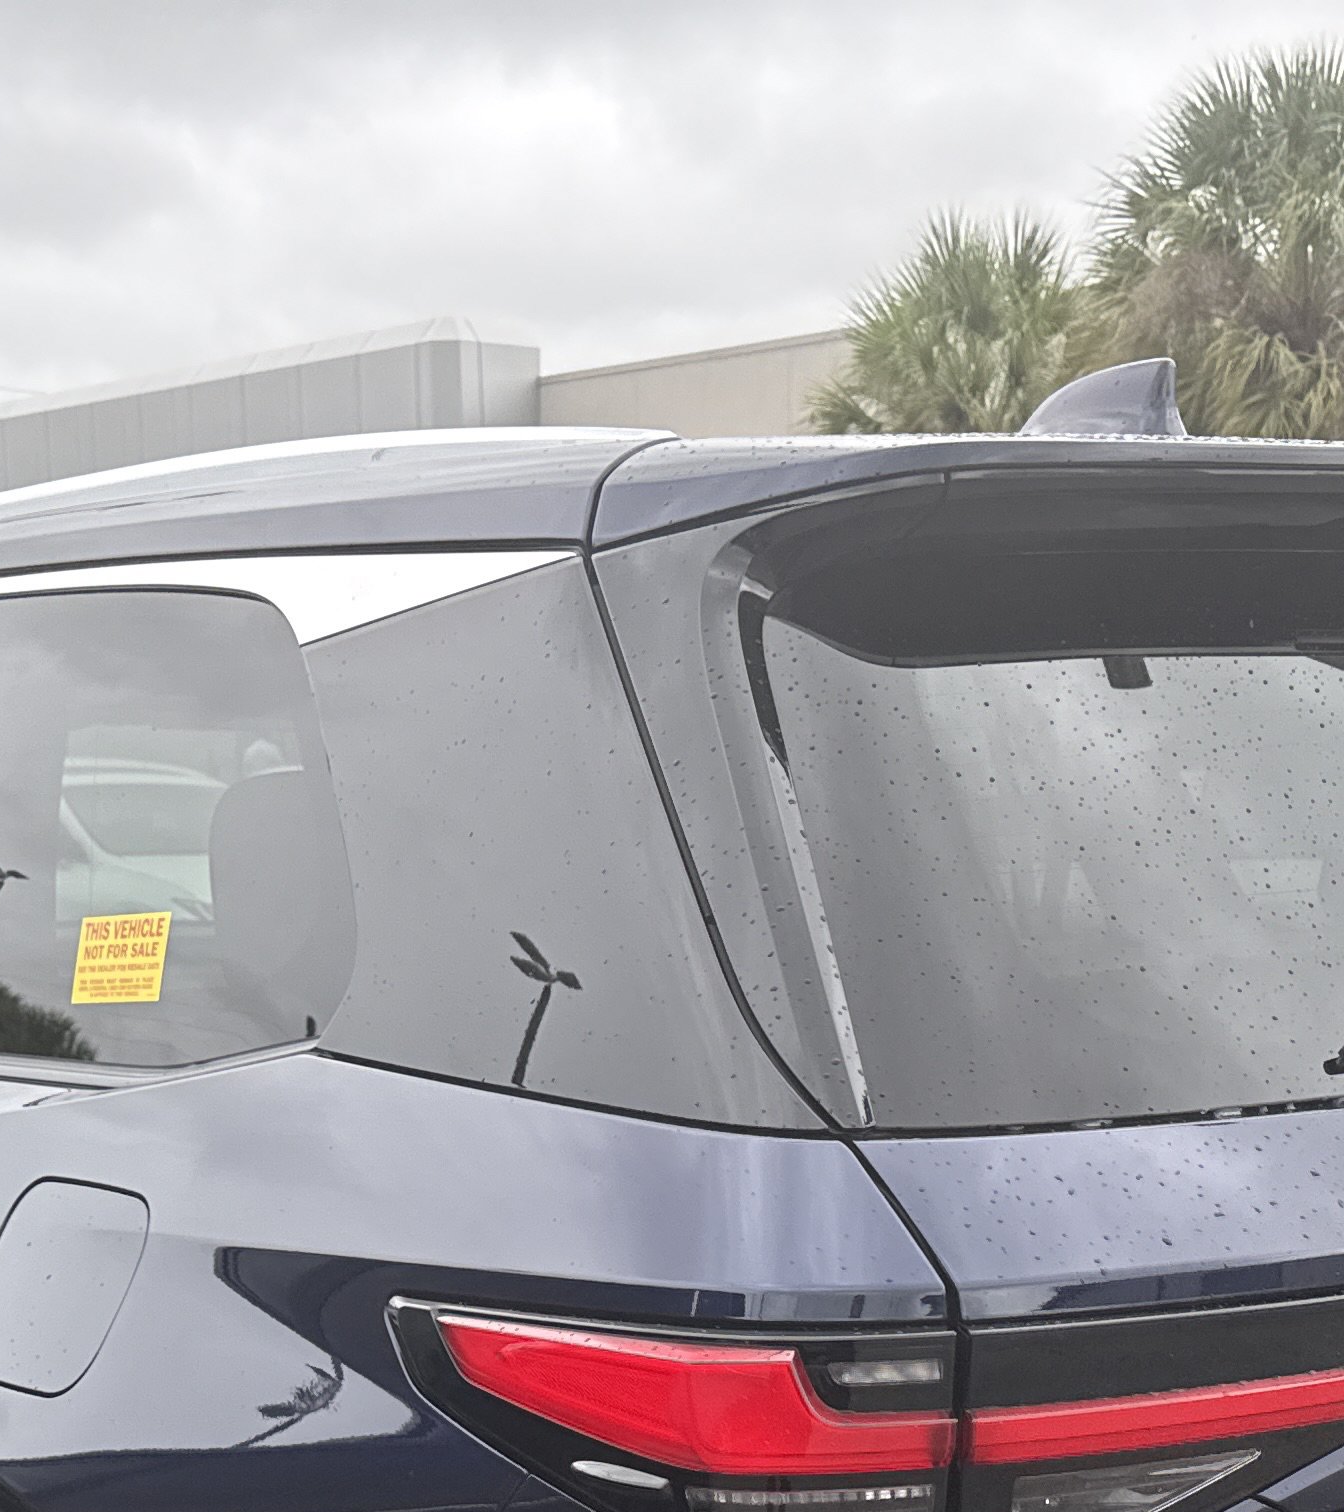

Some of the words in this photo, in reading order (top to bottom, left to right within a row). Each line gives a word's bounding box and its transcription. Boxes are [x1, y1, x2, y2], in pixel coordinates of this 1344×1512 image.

[85, 921, 111, 942] THIS
[114, 917, 166, 939] VEHICLE
[83, 945, 105, 960] NOT
[106, 943, 129, 959] FOR
[130, 941, 160, 958] SALE
